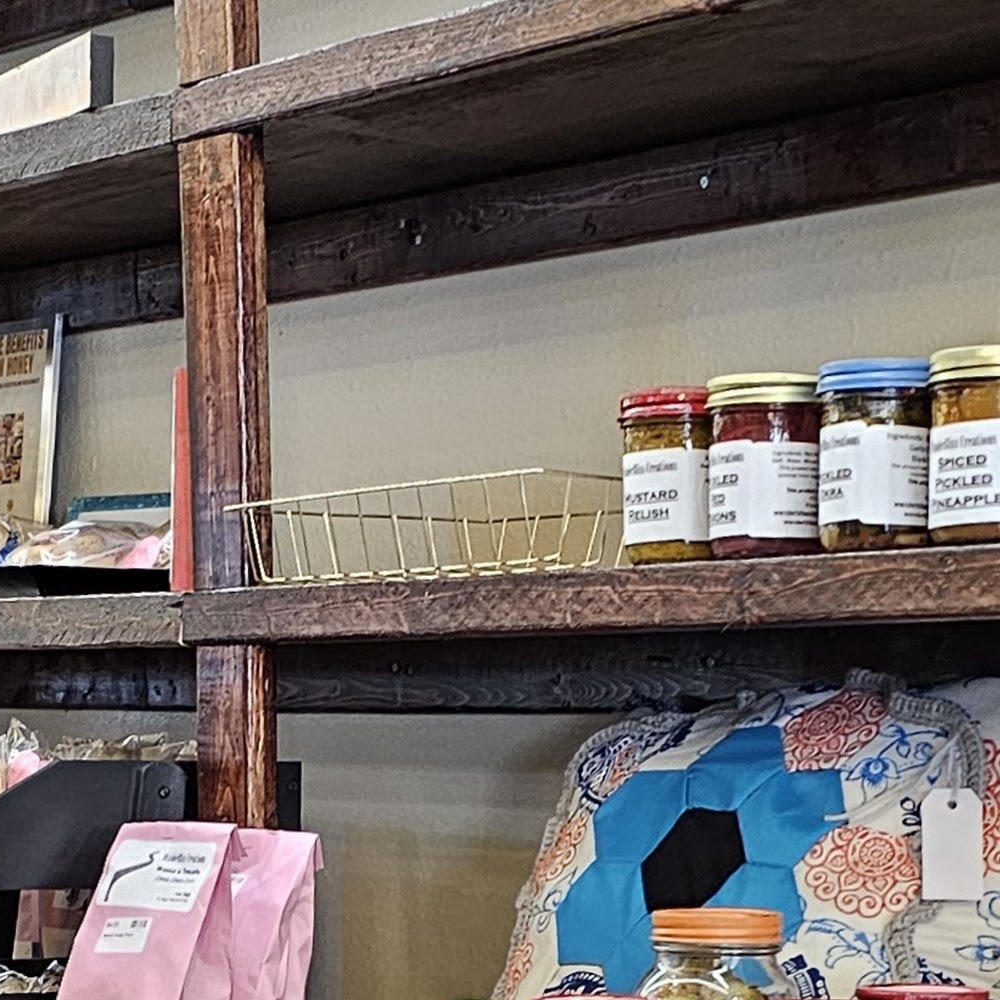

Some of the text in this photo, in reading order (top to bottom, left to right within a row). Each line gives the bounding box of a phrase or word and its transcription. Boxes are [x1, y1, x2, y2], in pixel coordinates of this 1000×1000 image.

[6, 332, 43, 355] BENEFITS
[6, 355, 32, 377] HONEY
[938, 454, 987, 470] SPICED
[628, 508, 669, 523] RELISH
